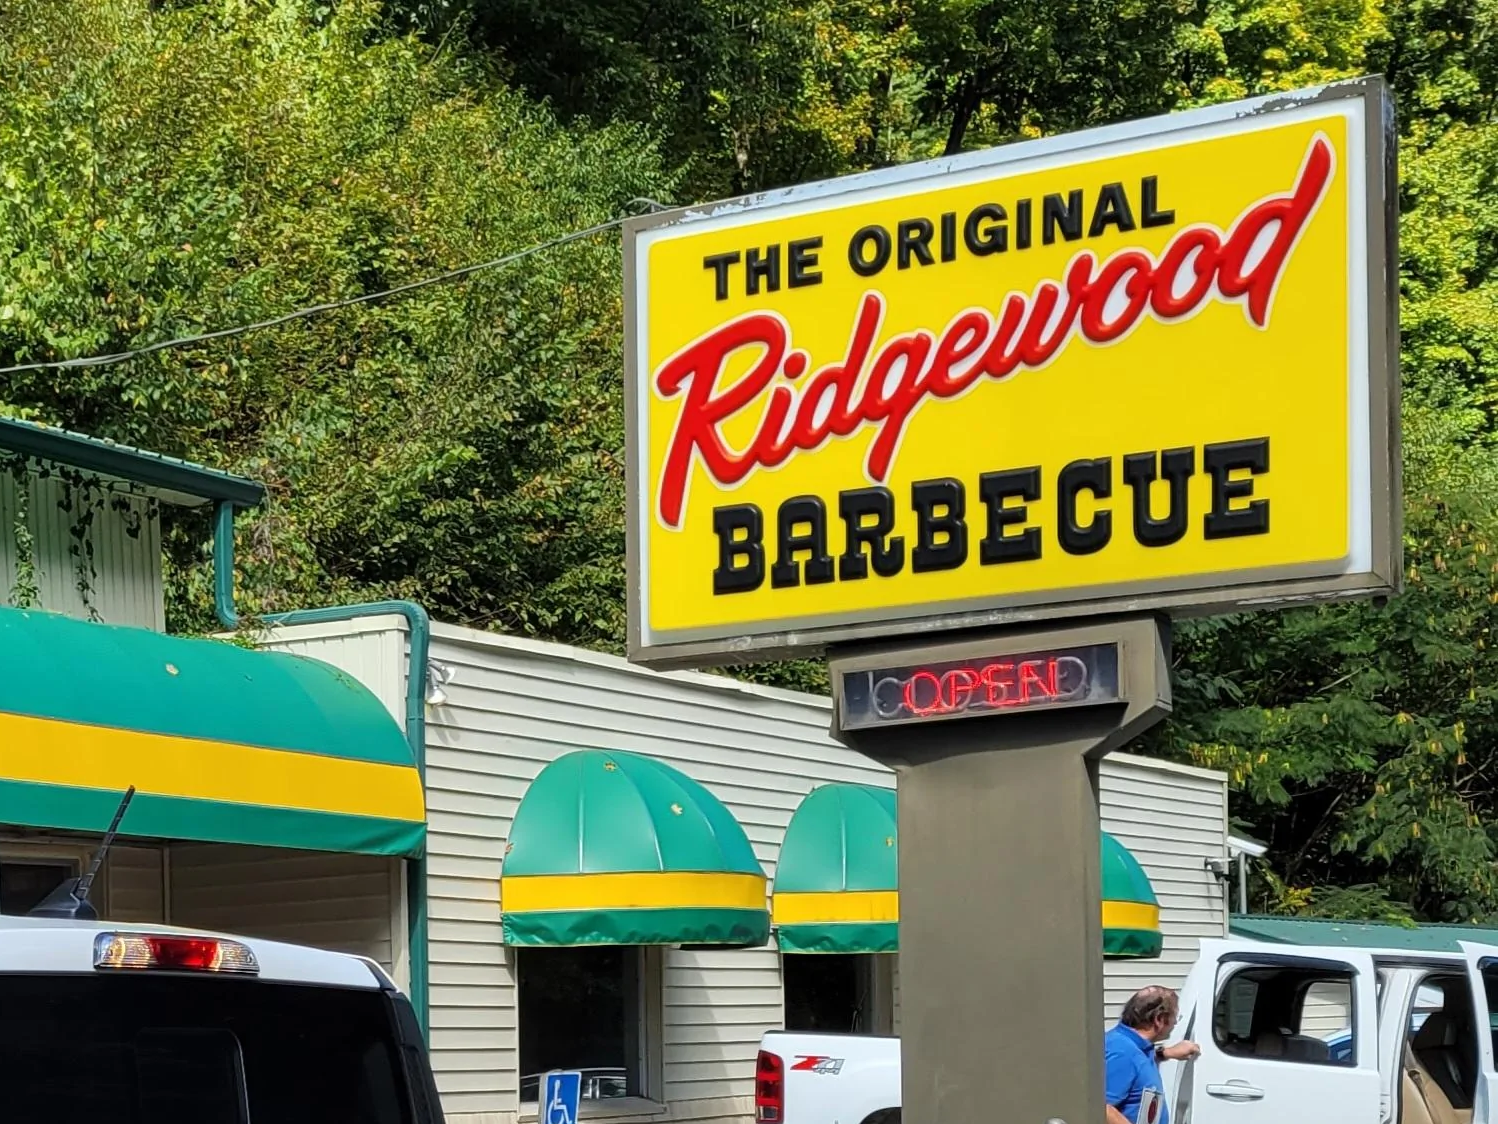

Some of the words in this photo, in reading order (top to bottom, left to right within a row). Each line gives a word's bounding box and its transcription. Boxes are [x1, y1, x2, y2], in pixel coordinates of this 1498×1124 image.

[703, 236, 824, 301] THE
[847, 175, 1176, 279] ORIGINAL
[654, 131, 1333, 528] Ridgewood
[711, 437, 1271, 596] BARBECUE
[902, 656, 1057, 719] OPEN
